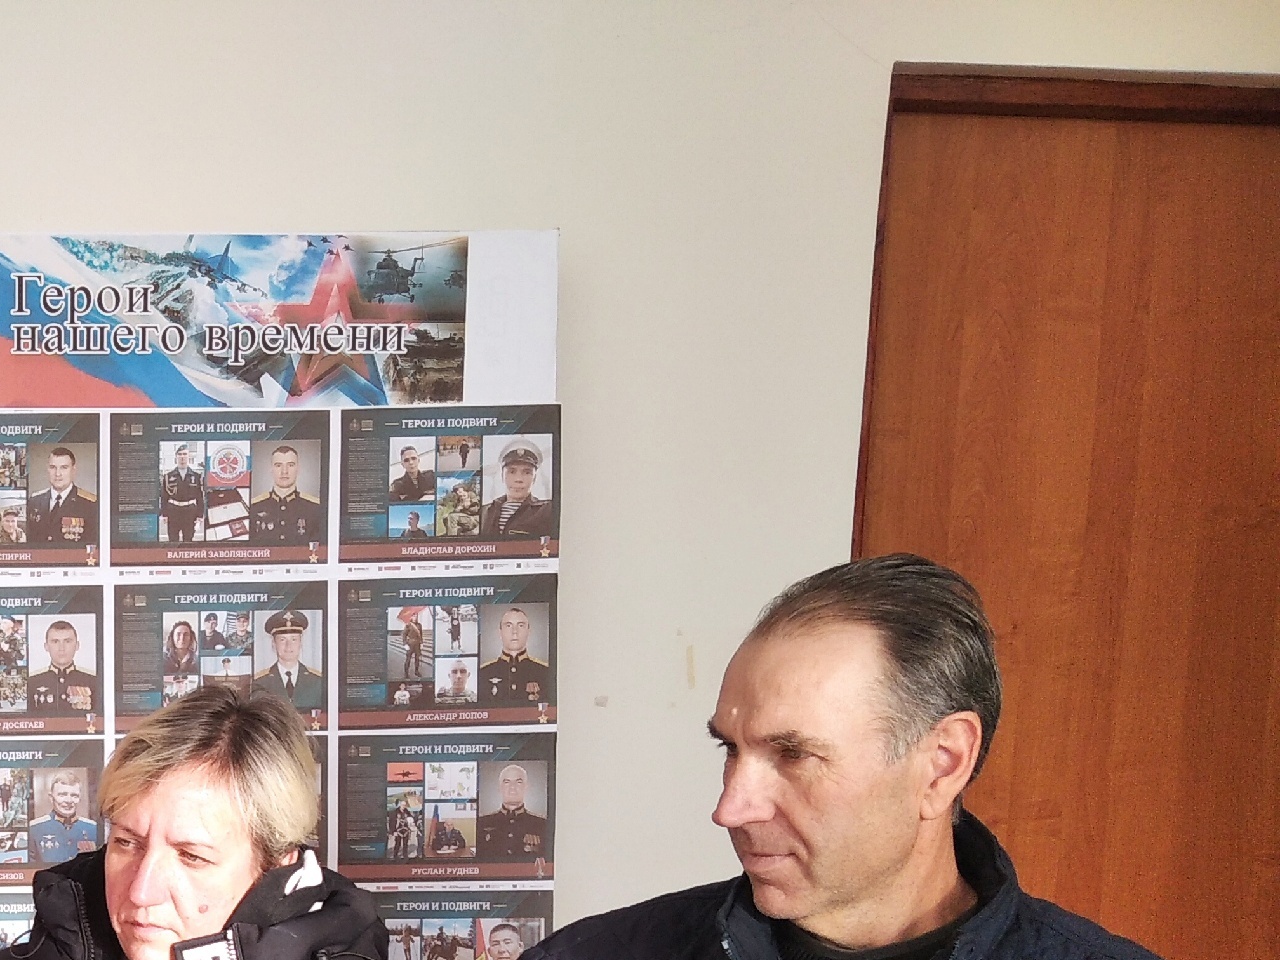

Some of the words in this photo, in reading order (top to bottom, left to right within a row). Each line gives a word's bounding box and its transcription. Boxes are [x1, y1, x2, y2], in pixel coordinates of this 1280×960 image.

[11, 273, 154, 322] Герои
[11, 322, 185, 354] нашего
[203, 322, 409, 365] времени
[171, 424, 204, 433] ГЕРОИ
[206, 424, 215, 432] И
[217, 423, 266, 433] ПОДВИГИ
[402, 419, 435, 429] ГЕРОИ
[437, 419, 445, 428] И
[447, 418, 497, 428] ПОДВИГИ
[167, 549, 207, 559] ВАЛЕРИЙ
[401, 546, 453, 555] ВЛАДИСЛАВ
[454, 545, 496, 555] ДОРОХИН
[399, 589, 432, 598] ГЕРОИ
[434, 588, 443, 597] И
[445, 587, 494, 597] ПОДВИГИ
[174, 595, 207, 604] ГЕРОИ
[209, 594, 217, 603] И
[219, 593, 268, 604] ПОДВИГИ
[406, 712, 457, 721] АЛЕКСАНДР
[459, 711, 489, 721] ПОПОВ
[411, 867, 445, 876] РУСЛАН
[446, 867, 480, 876] РУДНЕВ
[396, 902, 430, 911] ГЕРОИ
[432, 902, 440, 911] И
[441, 901, 491, 912] ПОДВИГИ
